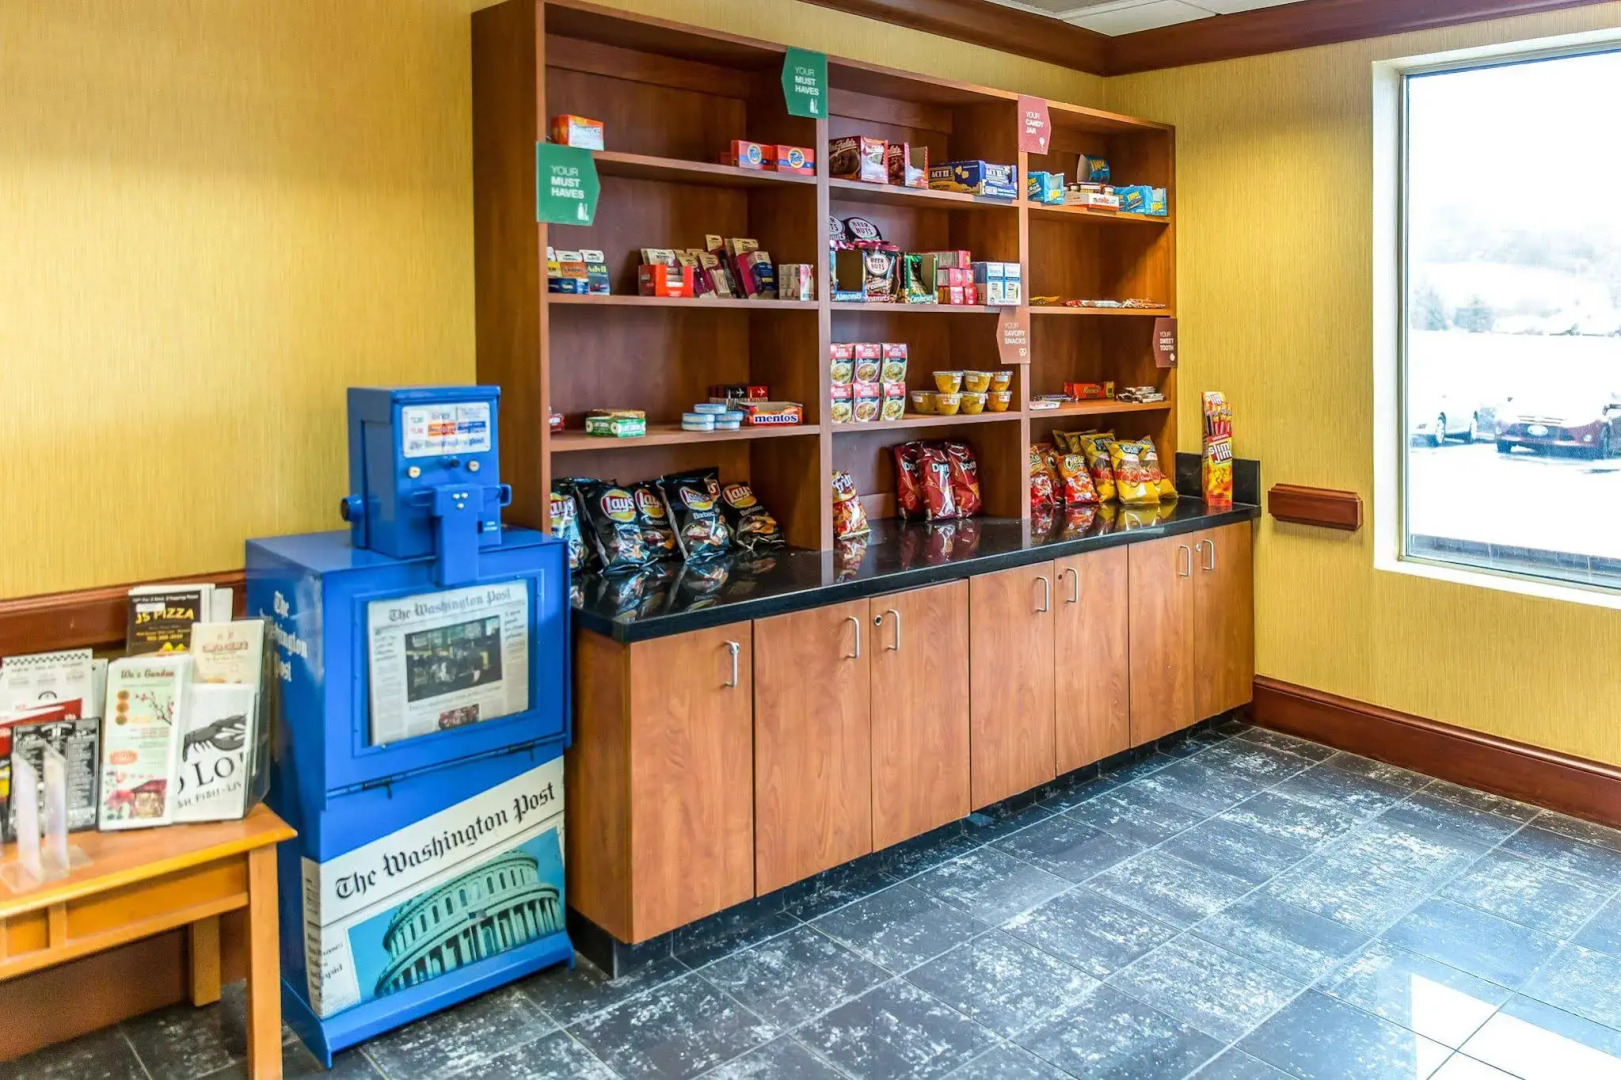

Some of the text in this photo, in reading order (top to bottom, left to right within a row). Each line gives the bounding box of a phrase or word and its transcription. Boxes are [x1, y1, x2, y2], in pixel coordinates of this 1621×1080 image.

[795, 66, 815, 77] YOUR
[794, 76, 816, 87] MUST
[794, 85, 820, 96] HAVES
[1025, 111, 1040, 119] YOUR
[1025, 119, 1045, 128] CANDY
[1025, 127, 1037, 135] JAR
[551, 165, 579, 177] YOUR
[551, 176, 581, 188] MUST
[551, 187, 585, 200] HAVES
[852, 220, 870, 229] BEER
[856, 227, 874, 236] NUTS
[587, 264, 608, 275] Advil
[871, 263, 885, 271] NUTS
[1004, 322, 1020, 330] YOUR
[1004, 337, 1027, 345] SNACKS
[1160, 344, 1175, 352] TOOTH
[754, 413, 799, 424] mentos
[388, 586, 512, 622] The Washington Post
[153, 607, 195, 620] PIZZA
[335, 866, 378, 900] The
[382, 807, 509, 879] Washington
[513, 781, 556, 824] Post
